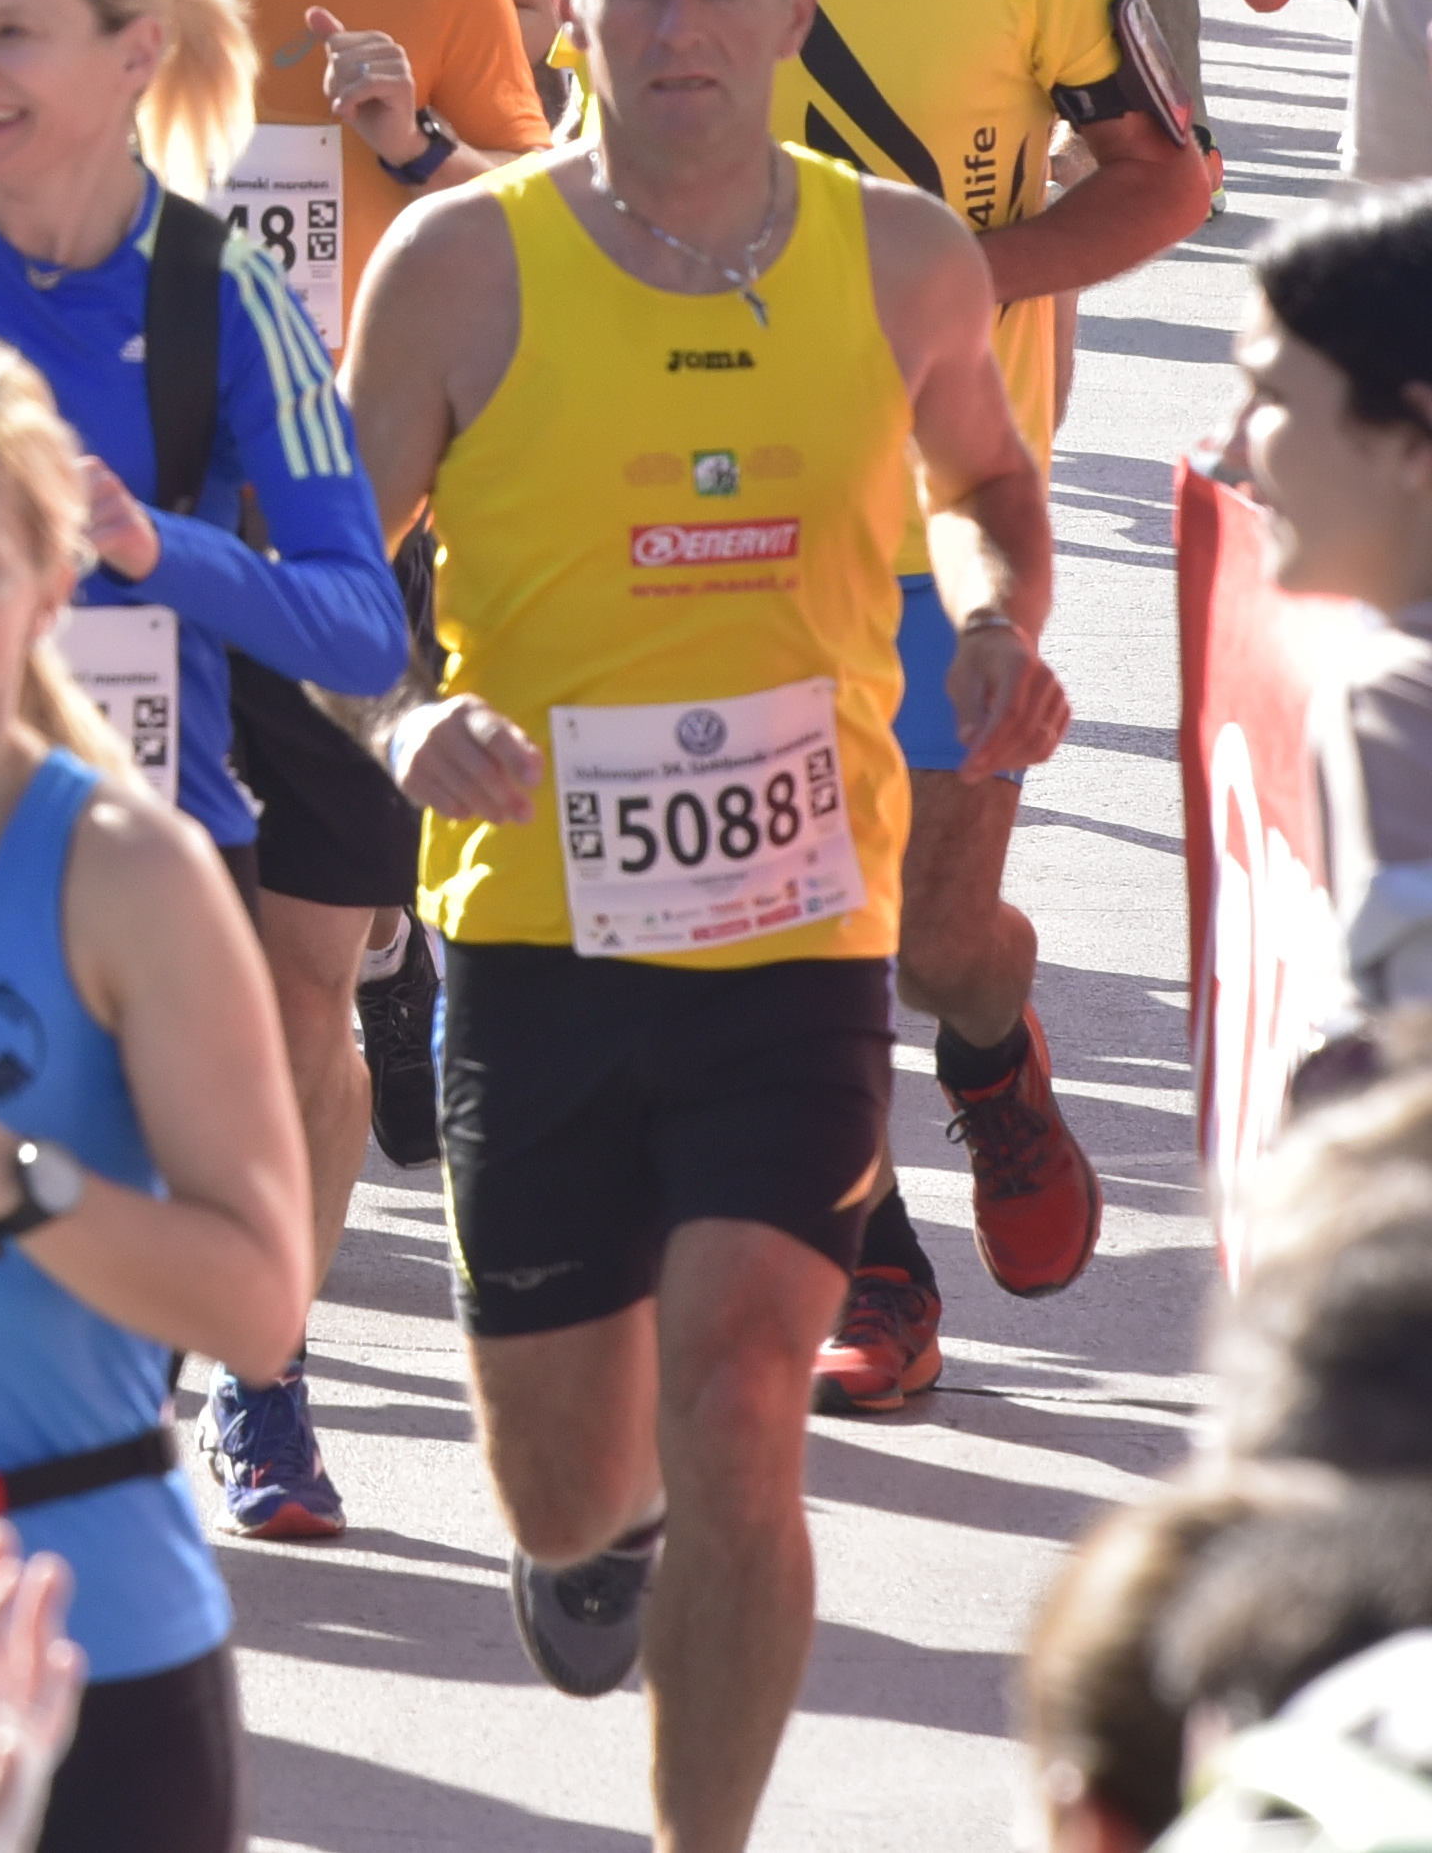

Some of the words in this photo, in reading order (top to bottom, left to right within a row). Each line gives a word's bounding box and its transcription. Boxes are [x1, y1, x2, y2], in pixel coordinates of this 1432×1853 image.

[273, 176, 330, 192] maraton
[963, 126, 997, 230] 4life
[686, 528, 796, 561] ENERVIT
[618, 770, 801, 875] 5088
